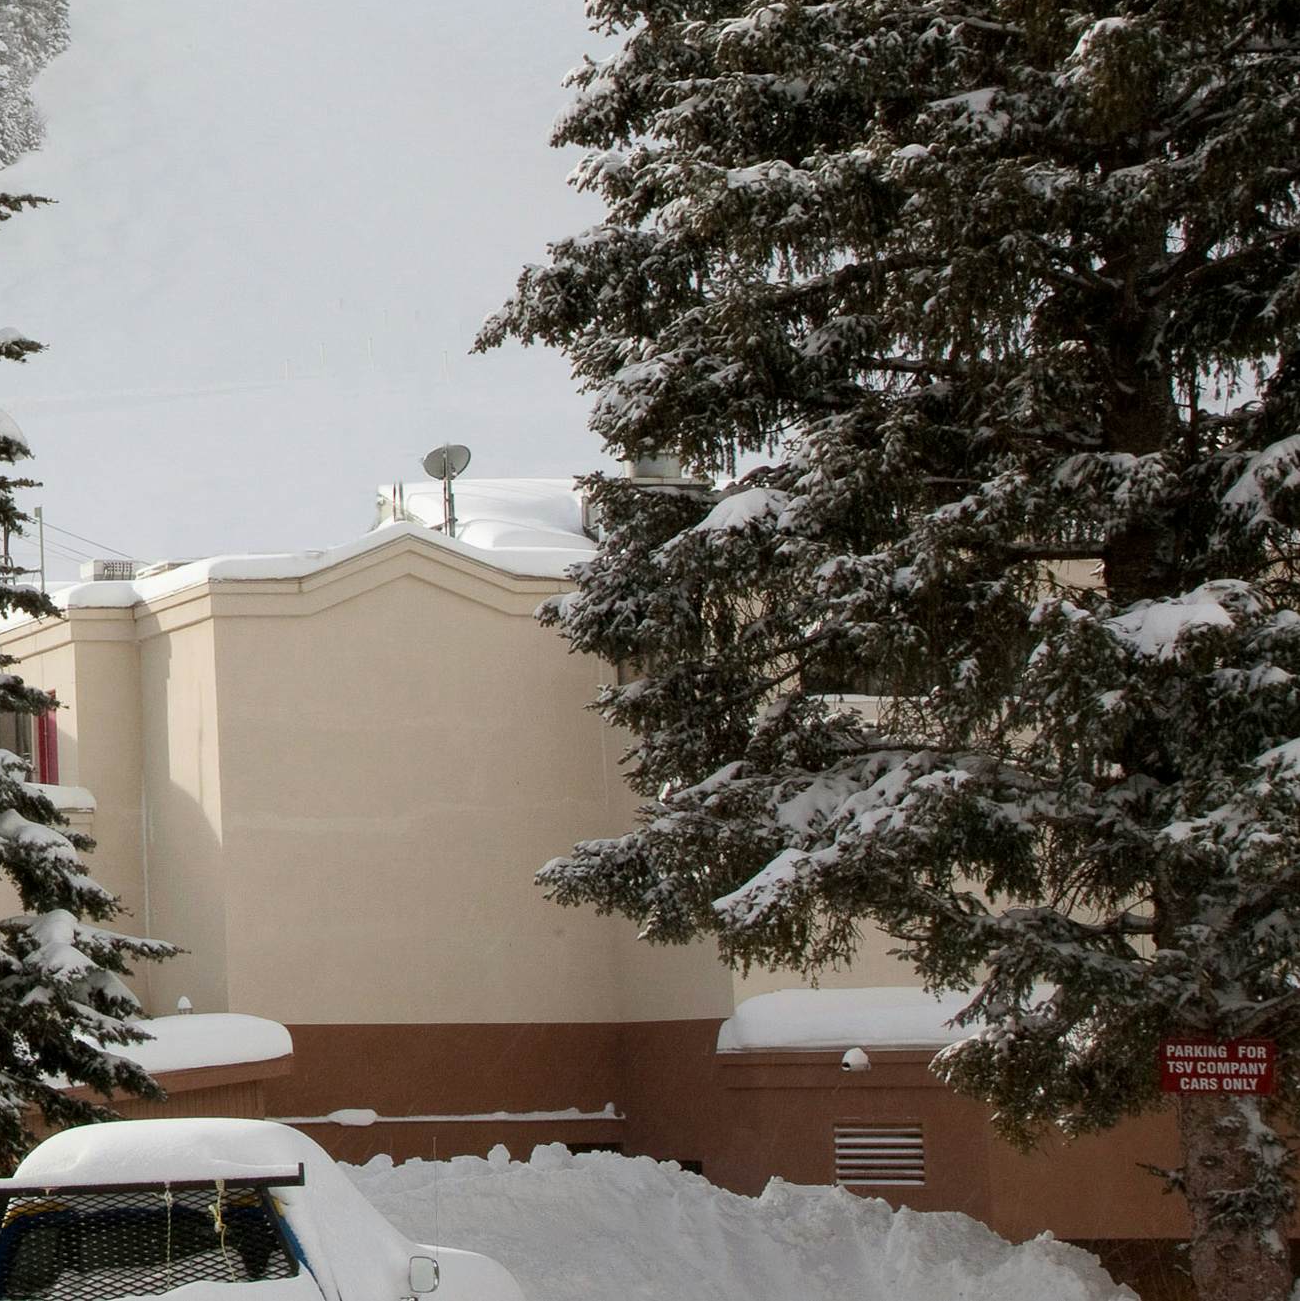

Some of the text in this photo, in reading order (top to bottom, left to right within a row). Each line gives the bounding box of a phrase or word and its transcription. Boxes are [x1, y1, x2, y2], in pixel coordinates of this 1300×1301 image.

[1166, 1045, 1267, 1058] PARKING FOR
[1167, 1061, 1267, 1075] TSV COMPANY
[1180, 1078, 1258, 1090] CARS ONLY
